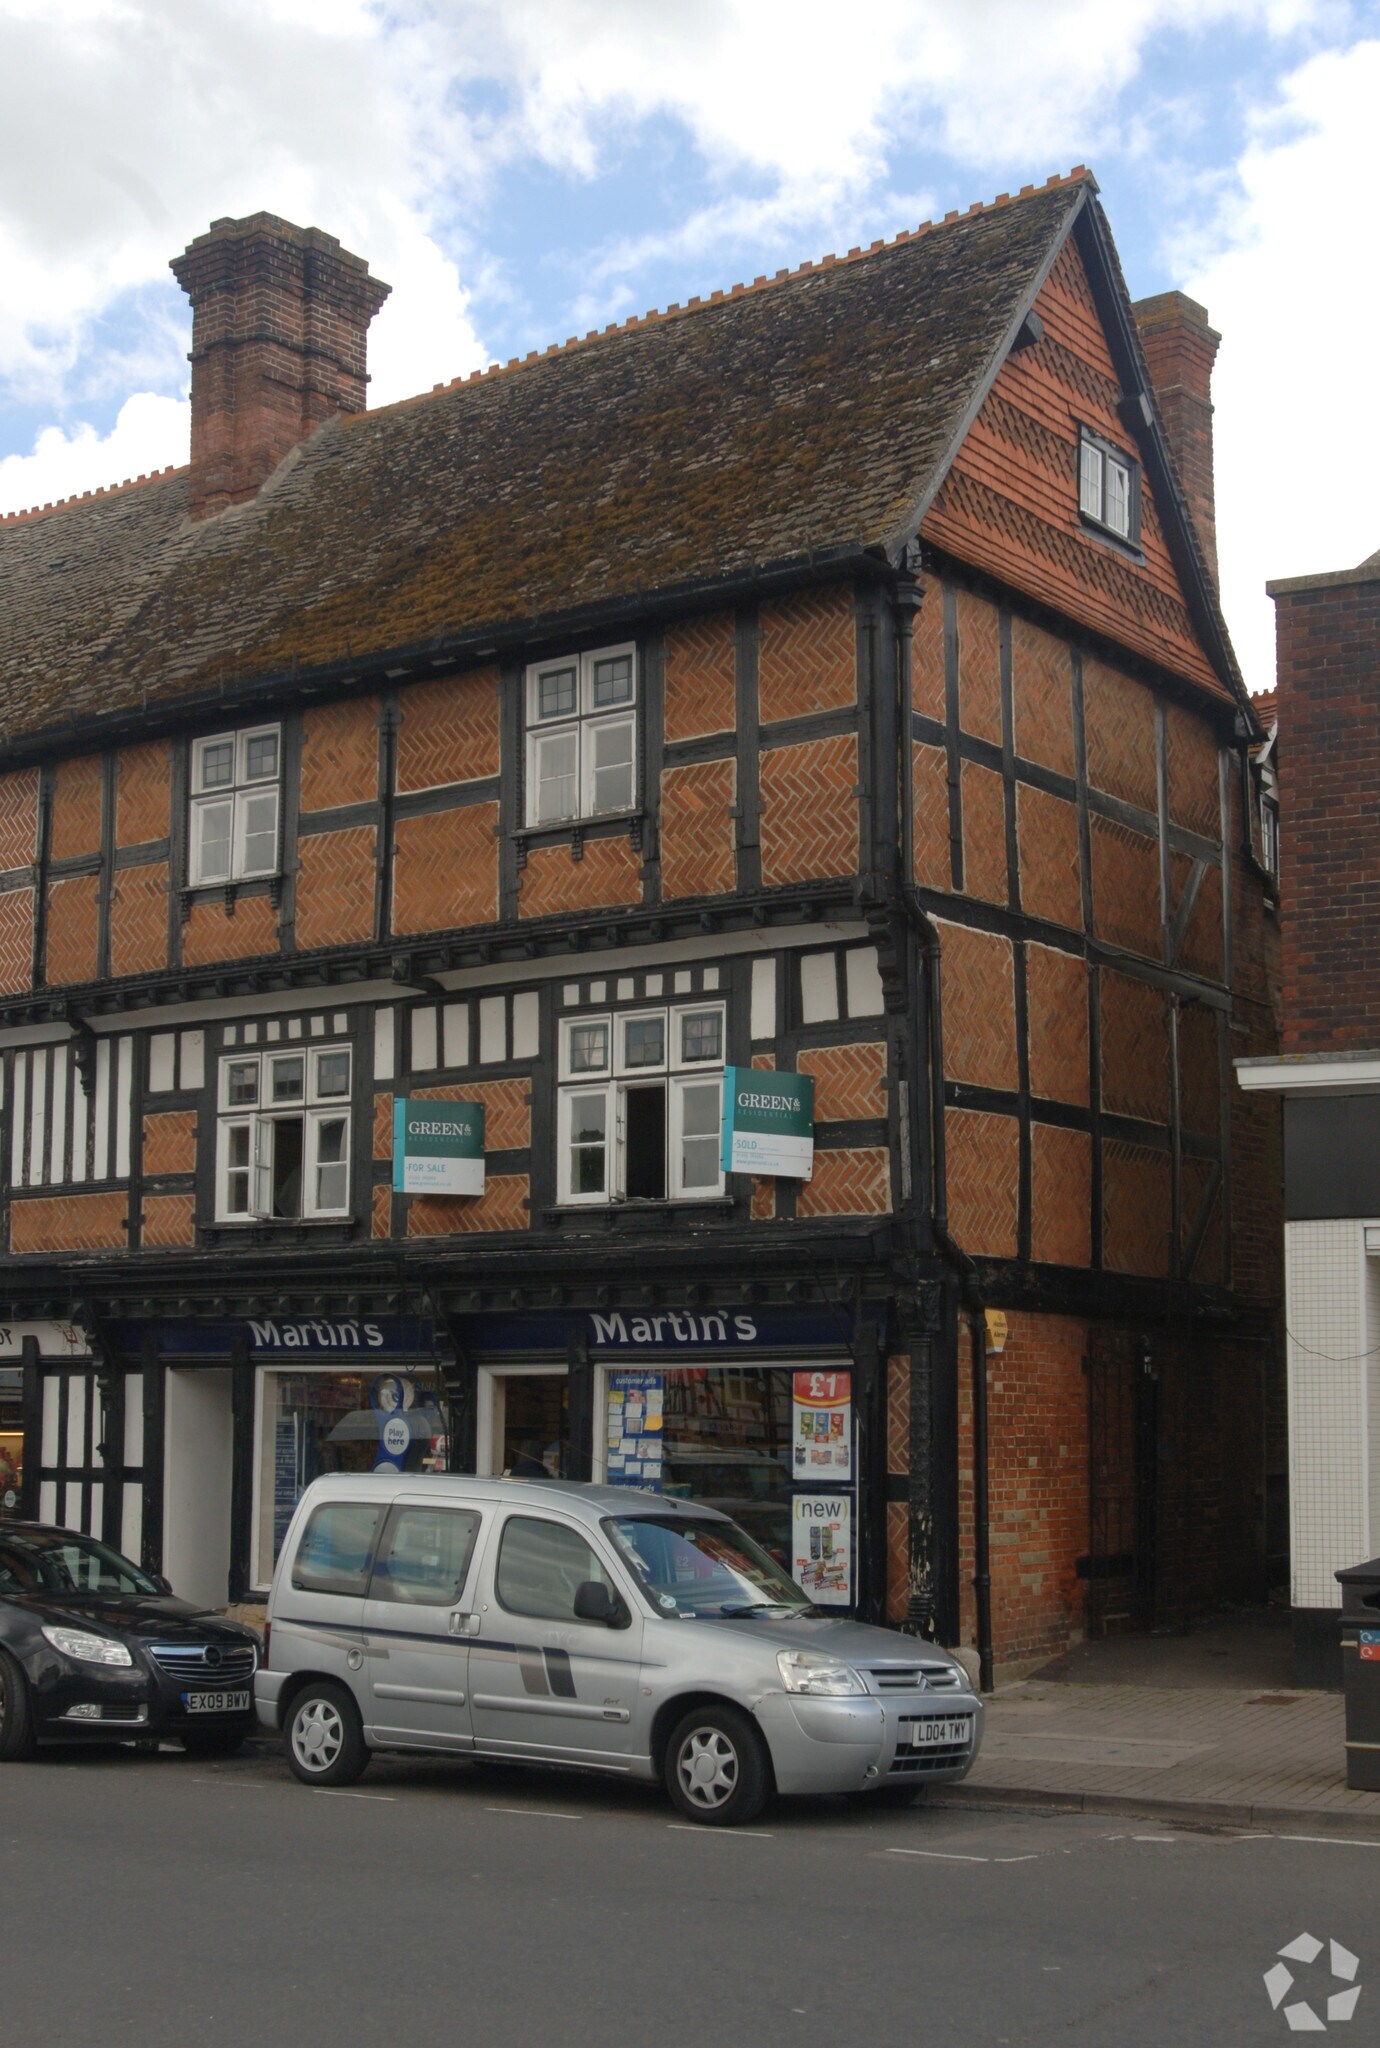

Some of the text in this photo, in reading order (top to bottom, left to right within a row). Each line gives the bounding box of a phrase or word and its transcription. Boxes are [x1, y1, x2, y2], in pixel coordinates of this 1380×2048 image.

[736, 1140, 757, 1149] SOLD
[408, 1163, 447, 1173] FOR SALE
[247, 1319, 384, 1347] Martin's
[589, 1310, 757, 1344] Martin's
[615, 1377, 643, 1385] customer
[810, 1373, 837, 1397] £1
[389, 1428, 404, 1438] Play
[388, 1437, 404, 1445] here
[190, 1695, 223, 1709] EX09
[918, 1722, 966, 1741] LD04 TMY
